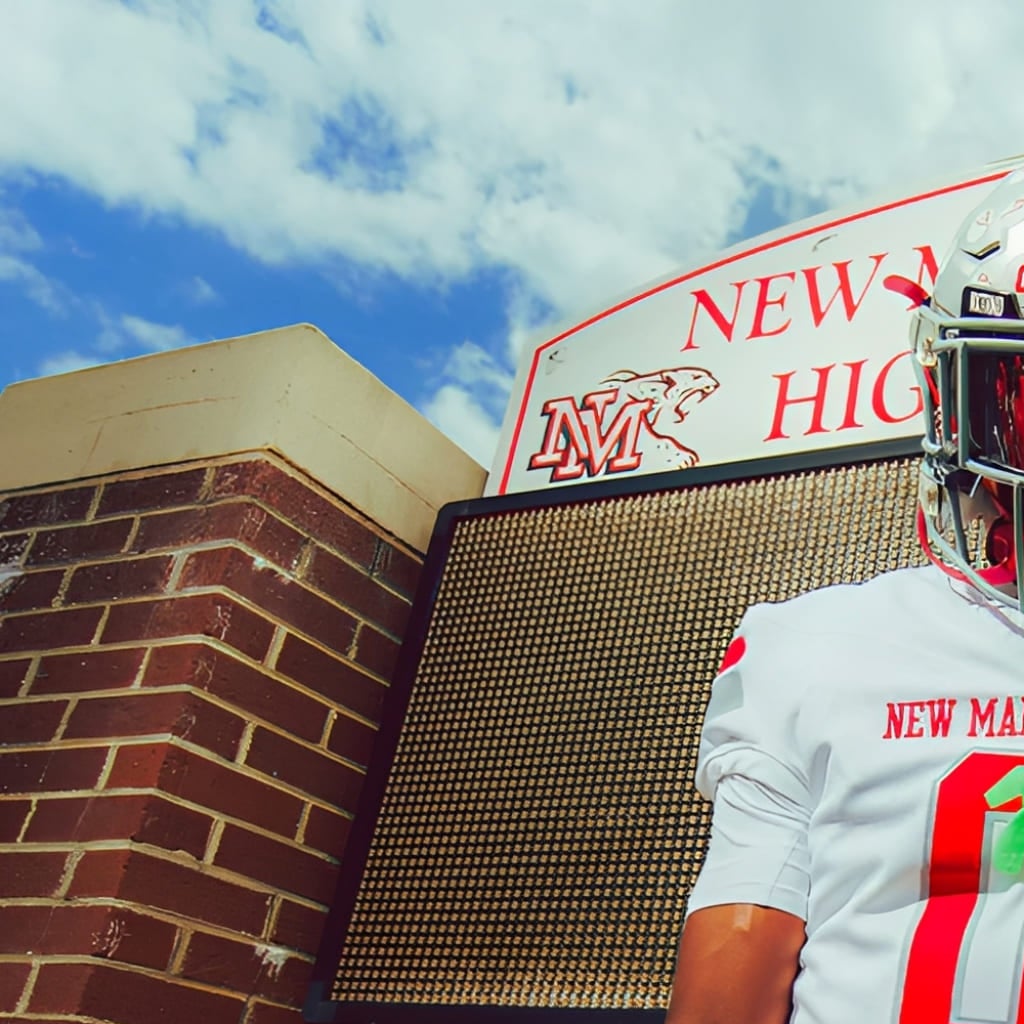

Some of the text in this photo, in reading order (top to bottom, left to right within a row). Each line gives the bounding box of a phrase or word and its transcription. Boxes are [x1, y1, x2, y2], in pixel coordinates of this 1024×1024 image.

[680, 252, 888, 351] NEW
[763, 350, 925, 441] HIG
[883, 698, 957, 739] NEW
